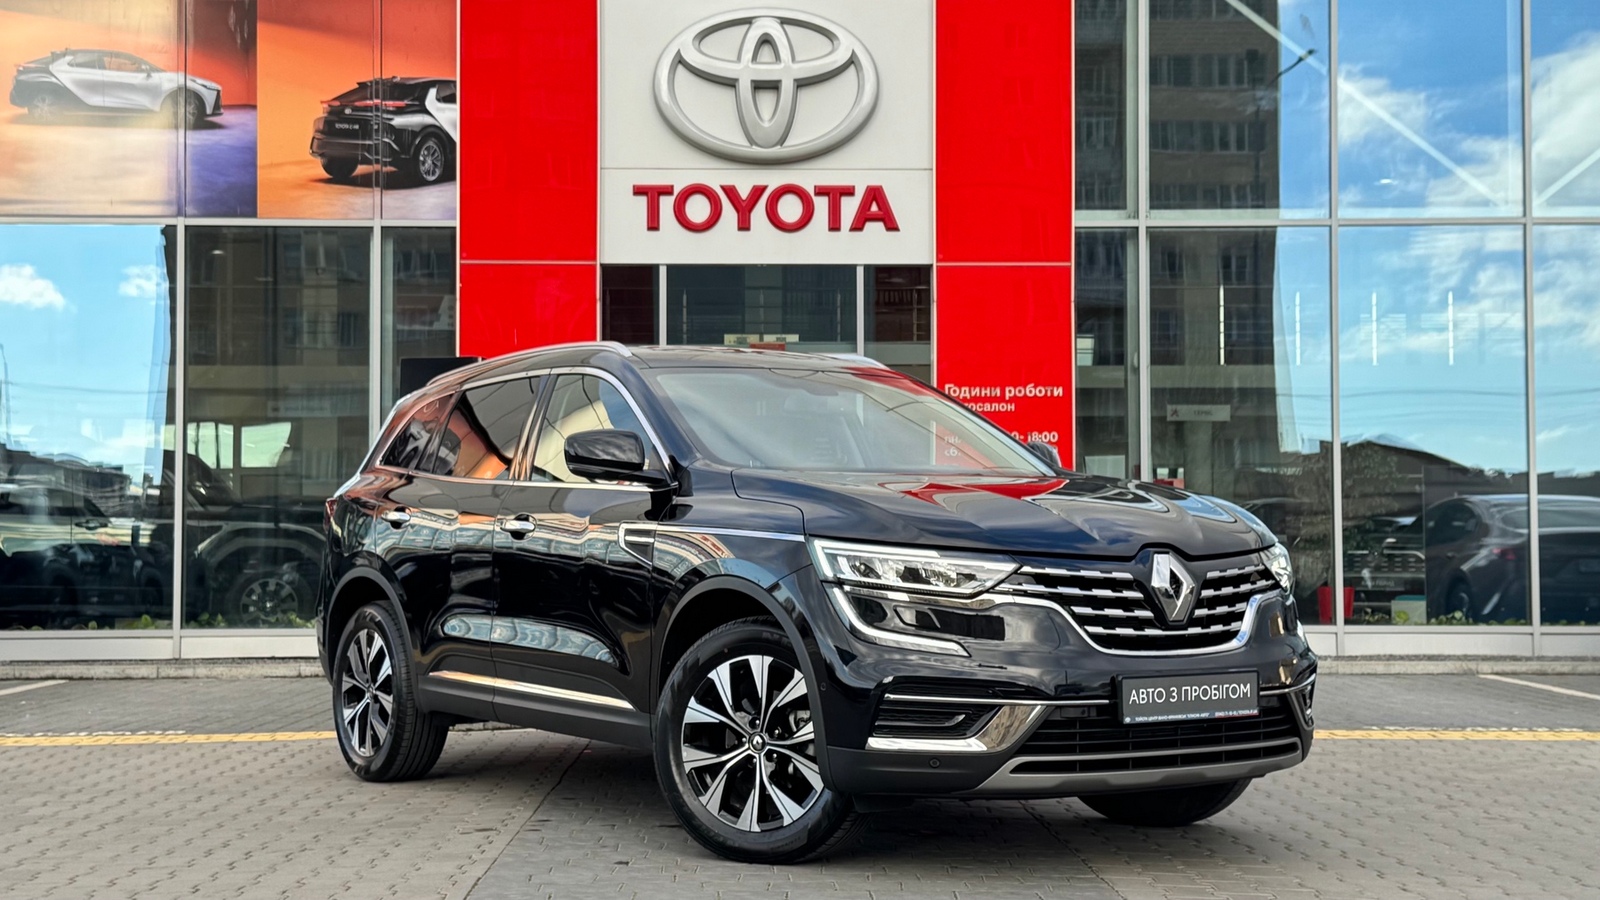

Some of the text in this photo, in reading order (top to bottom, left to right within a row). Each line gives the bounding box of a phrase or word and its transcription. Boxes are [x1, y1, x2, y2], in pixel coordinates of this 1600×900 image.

[633, 183, 900, 233] TOYOTA
[944, 383, 1063, 400] Години роботи
[964, 402, 1015, 412] осалон
[1129, 688, 1166, 704] АВТО
[1181, 683, 1251, 701] ПРОБІГОМ
